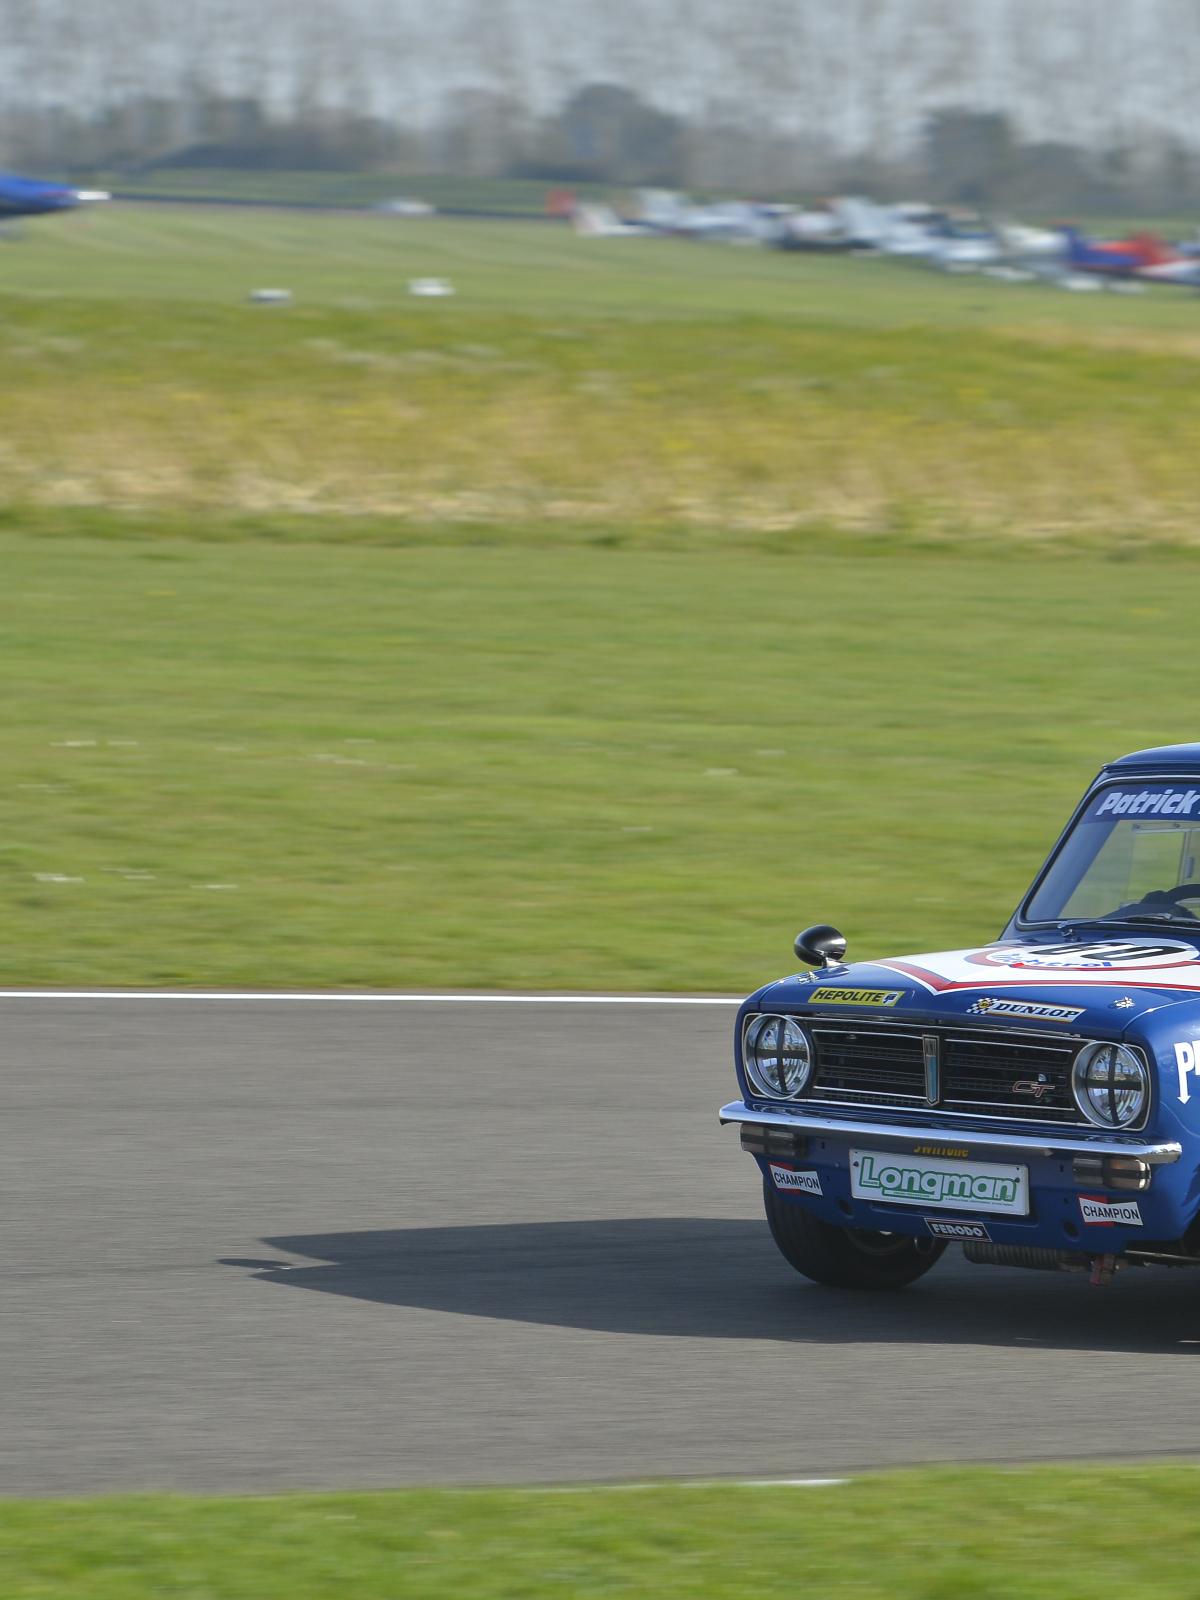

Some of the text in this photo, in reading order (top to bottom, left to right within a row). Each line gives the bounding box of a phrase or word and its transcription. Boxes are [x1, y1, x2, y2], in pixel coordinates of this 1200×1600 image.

[1096, 789, 1200, 816] Patrick
[814, 989, 886, 1003] HEPOLITE
[994, 1002, 1080, 1019] DUNLOP
[773, 1172, 820, 1189] CHAMPION
[859, 1156, 1017, 1201] Longman
[1082, 1205, 1140, 1220] CHAMPION
[930, 1223, 984, 1237] FERODO
